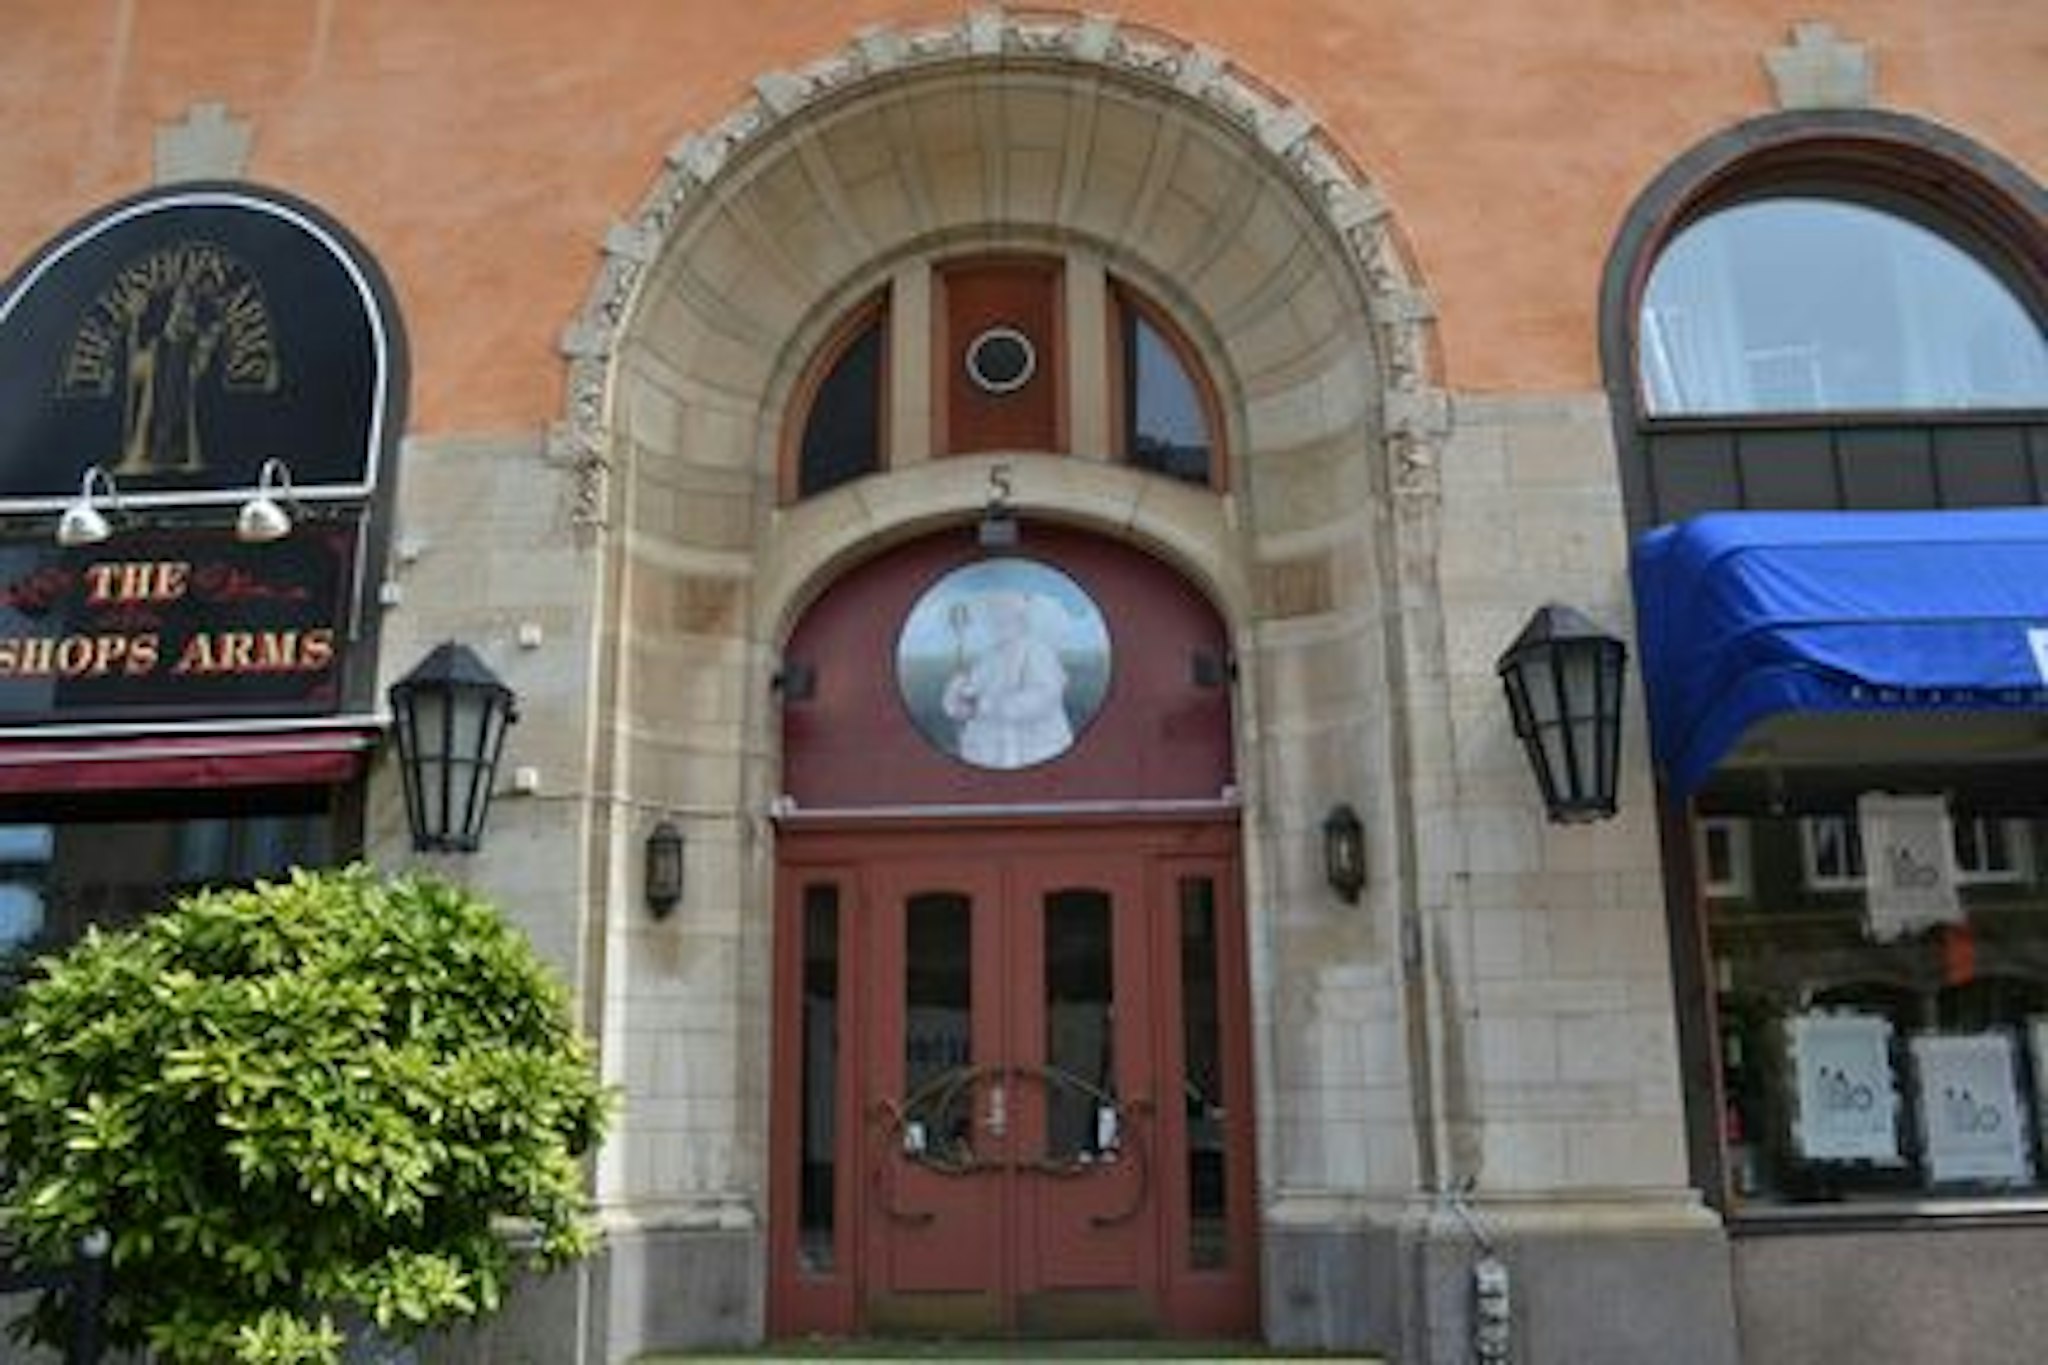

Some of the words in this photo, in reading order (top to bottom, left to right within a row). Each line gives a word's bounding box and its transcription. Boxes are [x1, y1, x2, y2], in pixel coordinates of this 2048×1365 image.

[989, 463, 1011, 500] 5
[86, 560, 191, 600] THE
[178, 628, 335, 672] ARMS
